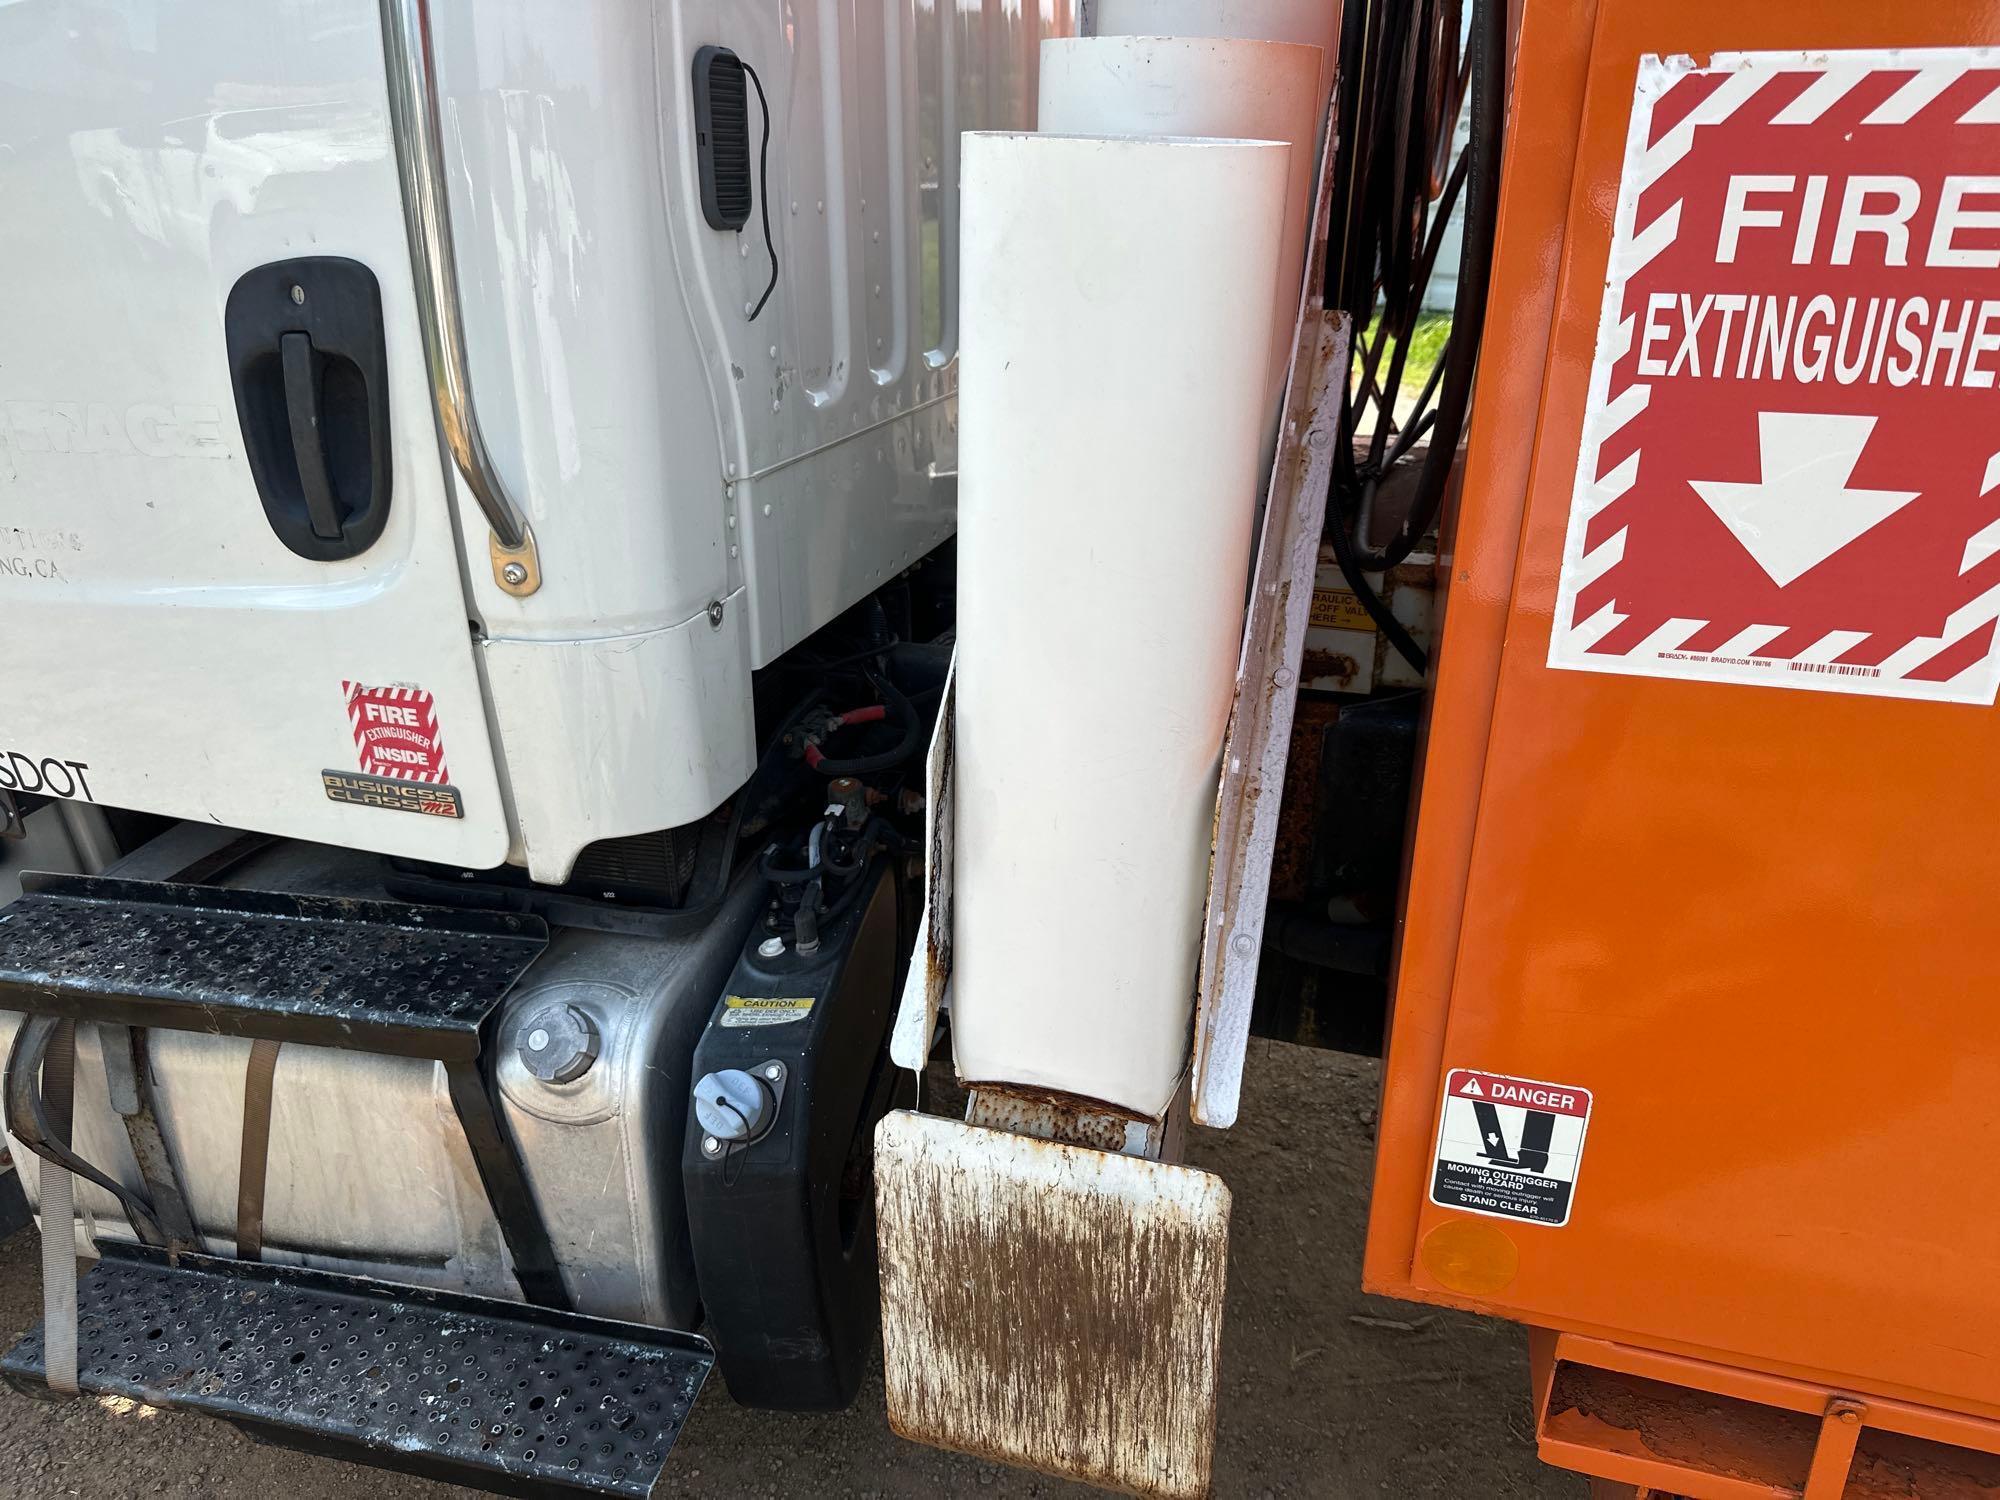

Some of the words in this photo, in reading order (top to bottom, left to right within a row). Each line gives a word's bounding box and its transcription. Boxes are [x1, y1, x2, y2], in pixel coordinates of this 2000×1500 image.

[1715, 175, 2000, 268] FIRE
[1637, 293, 2000, 389] EXTINGUISHE
[365, 703, 420, 727] FIRE
[366, 726, 431, 750] EXTINGUISHER
[373, 746, 430, 766] INSIDE
[323, 775, 455, 803] BUSINESS
[326, 788, 420, 810] CLASS
[743, 1000, 797, 1008] CAUTION
[1491, 1083, 1575, 1110] DANGER
[1447, 1163, 1490, 1177] MOVING
[1492, 1171, 1558, 1189] OUTRIGGER
[1478, 1176, 1524, 1190] HAZARD
[1444, 1178, 1470, 1187] Contact
[1486, 1186, 1511, 1195] moving
[1511, 1189, 1541, 1200] outrigger
[1465, 1187, 1484, 1195] death
[1493, 1192, 1518, 1201] serious
[1460, 1193, 1497, 1207] STAND
[1499, 1200, 1539, 1215] CLEAR
